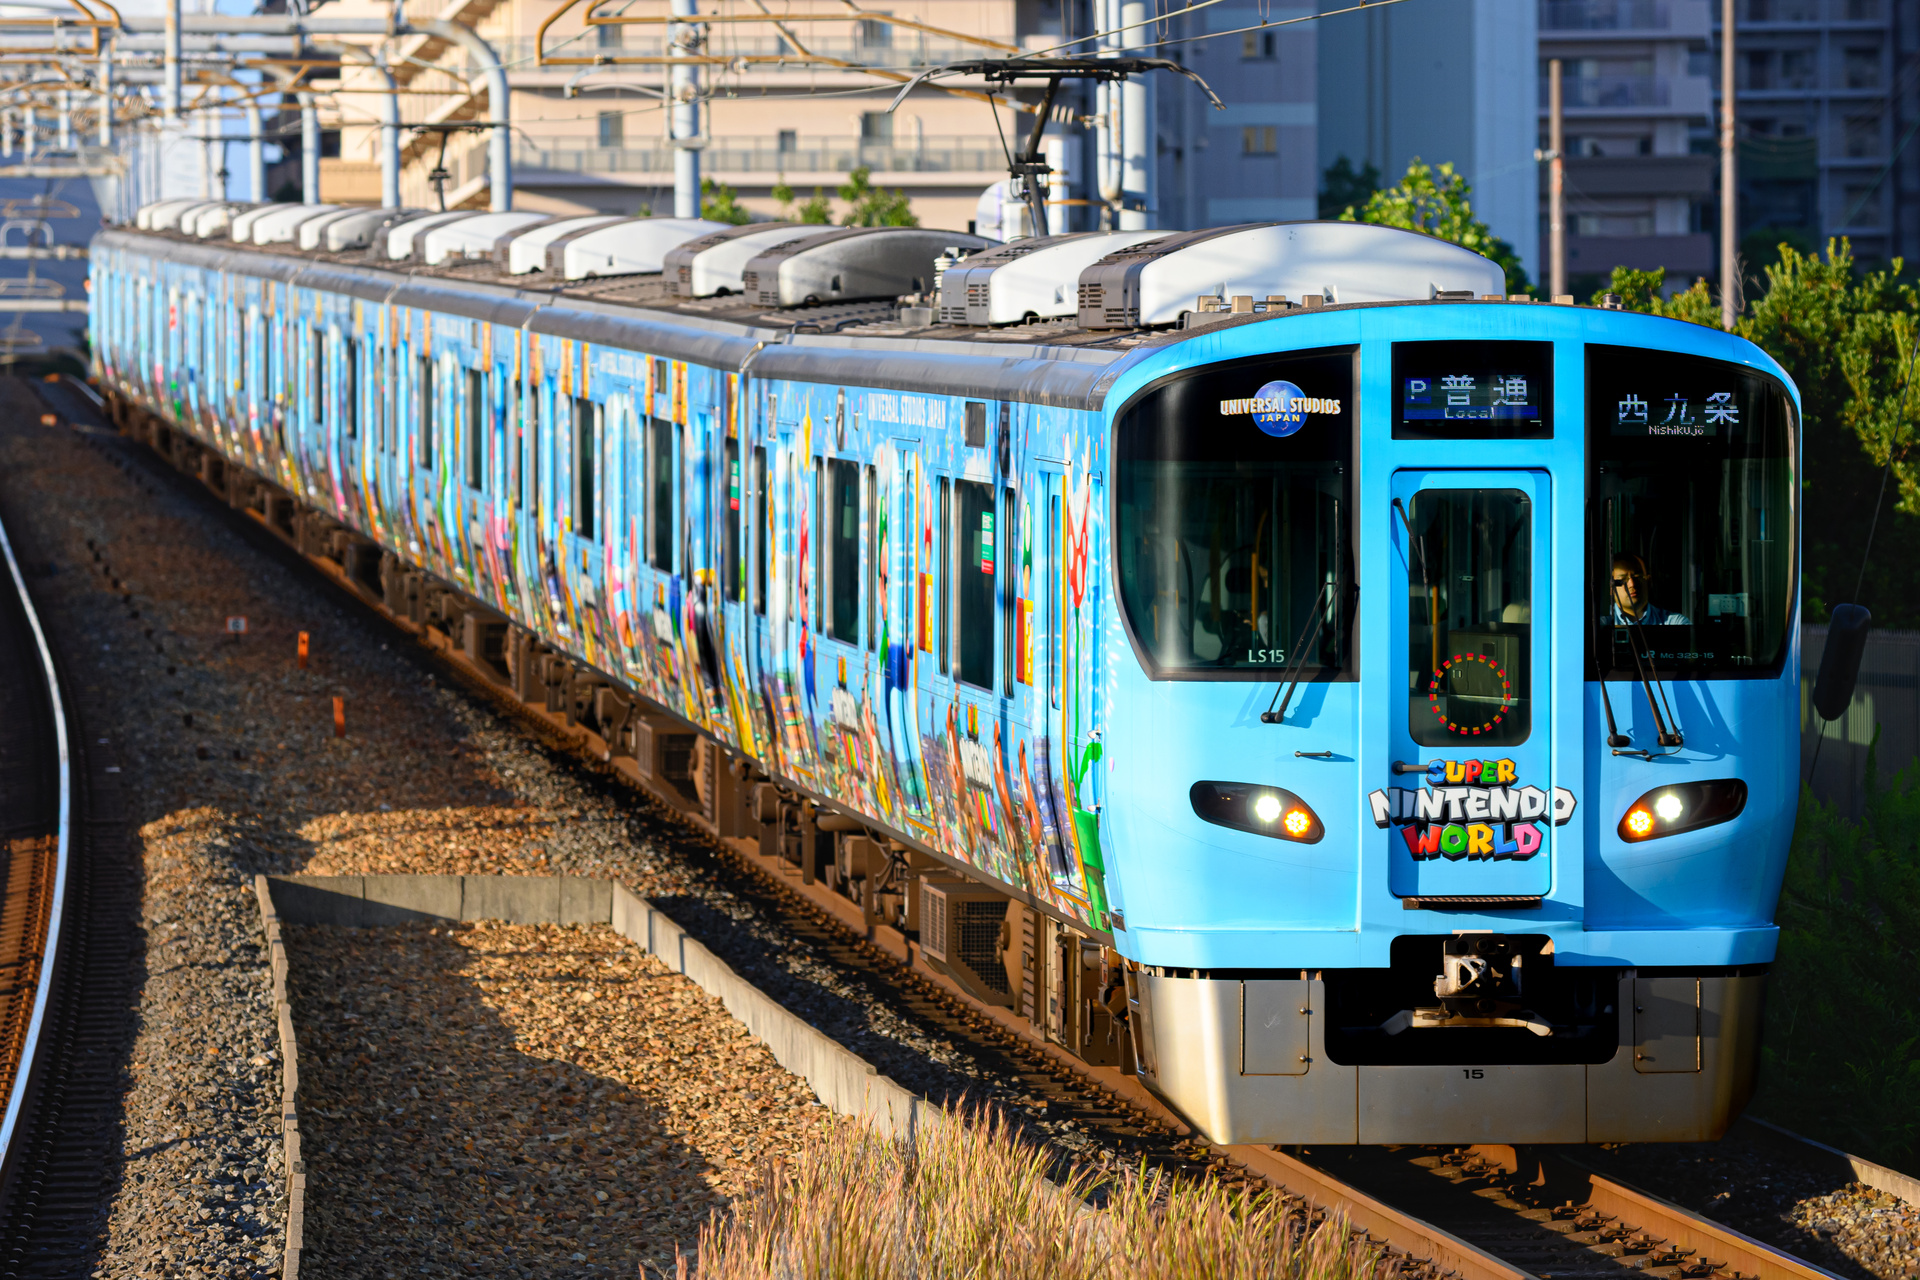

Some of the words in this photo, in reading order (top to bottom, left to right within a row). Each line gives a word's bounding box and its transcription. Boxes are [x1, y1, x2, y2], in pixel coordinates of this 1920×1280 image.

[1410, 380, 1427, 400] P
[1440, 374, 1528, 406] 普通
[1220, 397, 1287, 416] UNIVERSAL
[1290, 397, 1341, 415] STUDIOS
[1444, 406, 1495, 419] Local
[1618, 392, 1740, 425] 西九条
[1260, 414, 1300, 422] JAPAN
[1248, 649, 1285, 663] LS15
[1641, 650, 1655, 659] JR
[1425, 758, 1519, 787] SUPER
[1368, 785, 1577, 829] NINTENDO
[1401, 821, 1544, 862] WORLD
[1462, 1069, 1484, 1080] 15
